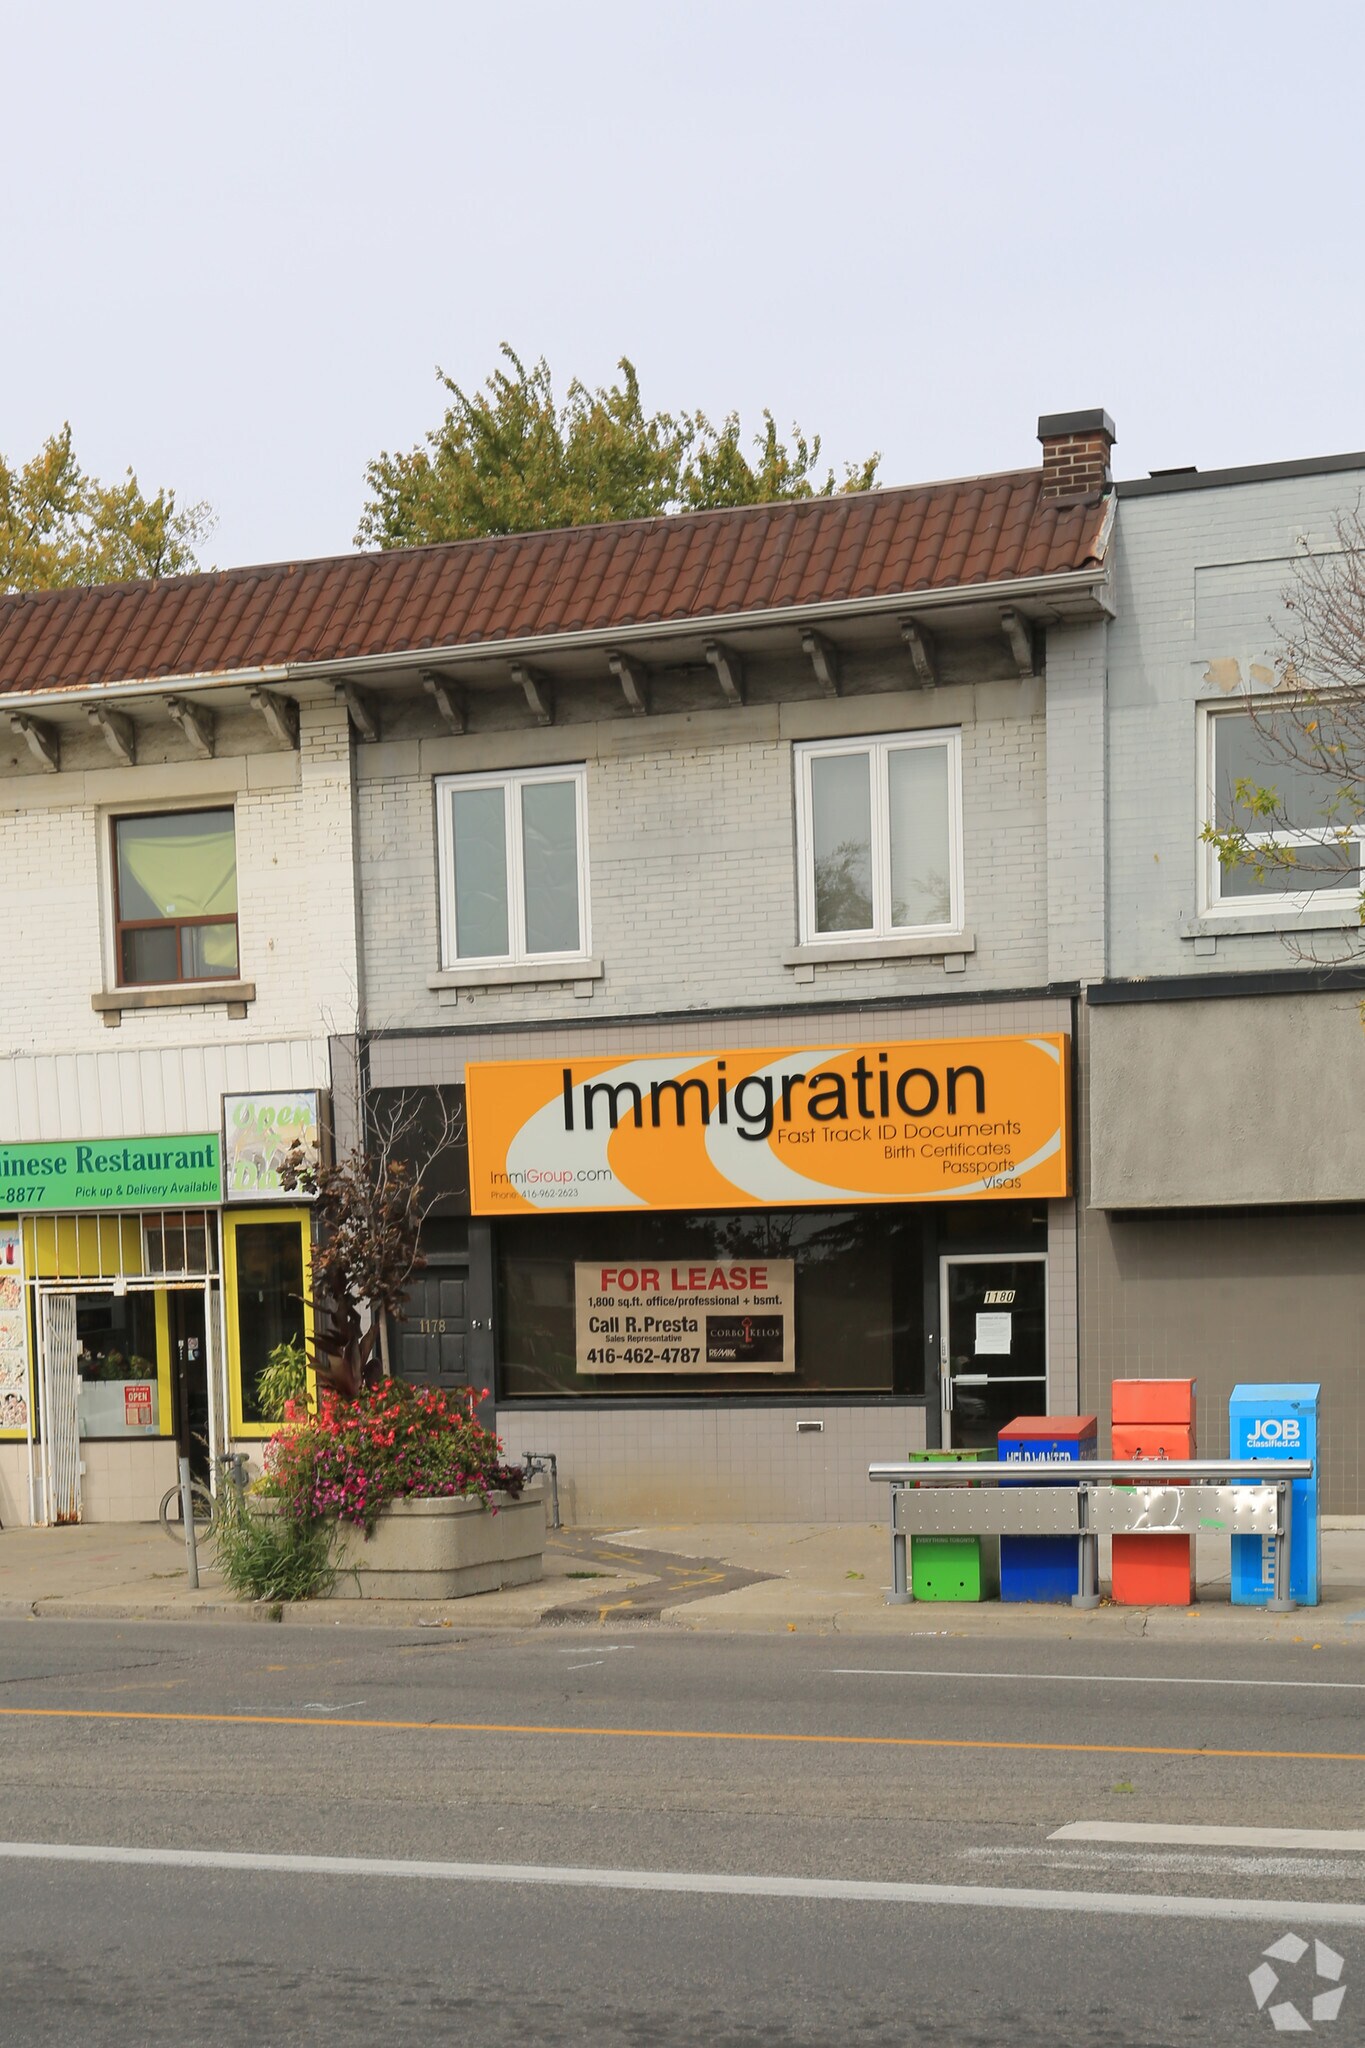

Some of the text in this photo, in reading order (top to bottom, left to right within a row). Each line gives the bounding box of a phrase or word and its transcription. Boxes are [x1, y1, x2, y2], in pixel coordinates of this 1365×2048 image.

[562, 1053, 986, 1141] Immigration
[233, 1104, 311, 1134] Open
[777, 1119, 1021, 1144] Fast Track ID Documents
[884, 1141, 1011, 1159] Birth Certificates
[76, 1144, 215, 1174] Restaurant
[942, 1158, 1015, 1175] Passports
[490, 1169, 612, 1184] ImmiGroup.com
[981, 1174, 1021, 1189] Visas
[75, 1186, 97, 1198] Pick
[100, 1188, 113, 1199] up
[116, 1185, 123, 1196] &
[126, 1183, 168, 1197] Delivery
[170, 1181, 218, 1194] Available
[522, 1188, 579, 1199] 416-962-2623
[601, 1266, 768, 1292] FOR LEASE
[588, 1297, 615, 1308] 1,800
[618, 1296, 643, 1308] sq.ft.
[646, 1295, 739, 1308] office/professional
[753, 1295, 782, 1305] bsmt.
[985, 1291, 1014, 1303] 1180
[419, 1319, 446, 1333] 1178
[589, 1316, 619, 1333] Call
[710, 1329, 744, 1337] CORBO
[627, 1334, 682, 1343] Representative
[587, 1347, 701, 1364] 416-462-4787
[128, 1392, 148, 1402] OPEN
[1246, 1419, 1301, 1440] JOB
[1246, 1440, 1300, 1448] Classified.ca
